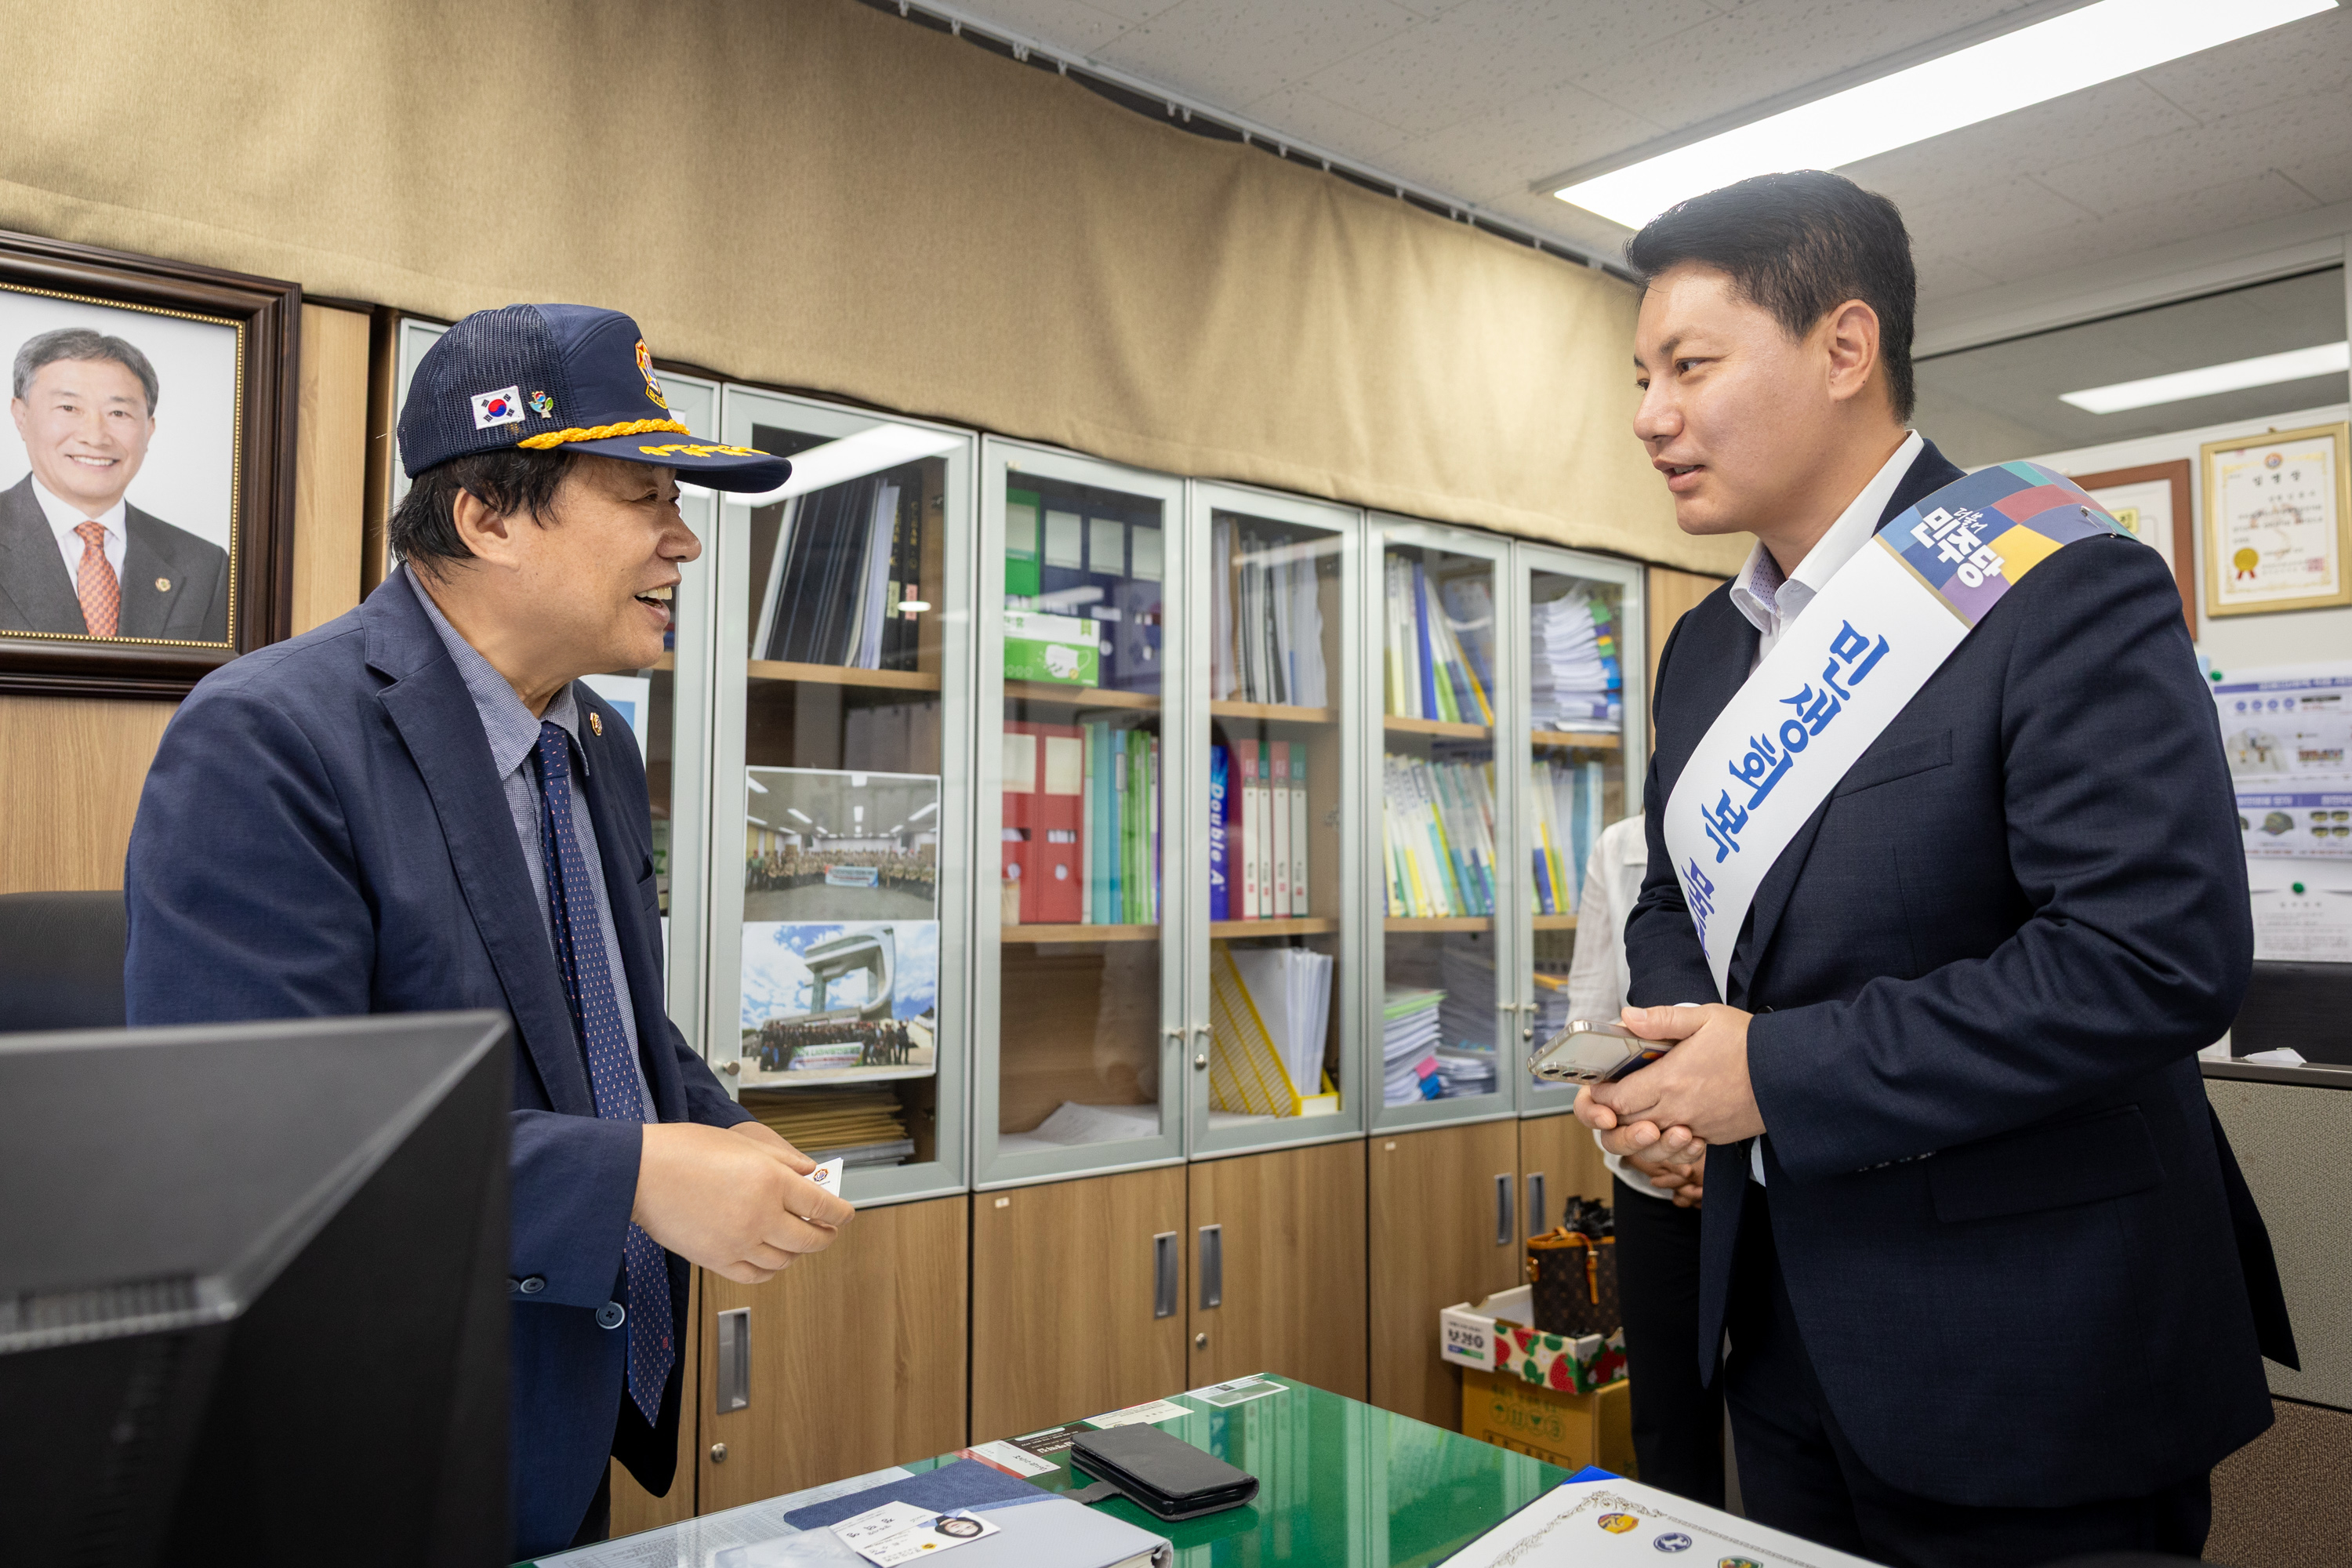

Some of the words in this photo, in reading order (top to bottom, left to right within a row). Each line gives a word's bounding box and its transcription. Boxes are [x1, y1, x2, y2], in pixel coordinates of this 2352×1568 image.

[1909, 506, 2006, 588] 민주당
[1953, 506, 1988, 535] 더불어
[1701, 619, 1890, 864] 민생회복
[1210, 783, 1225, 862] Double
